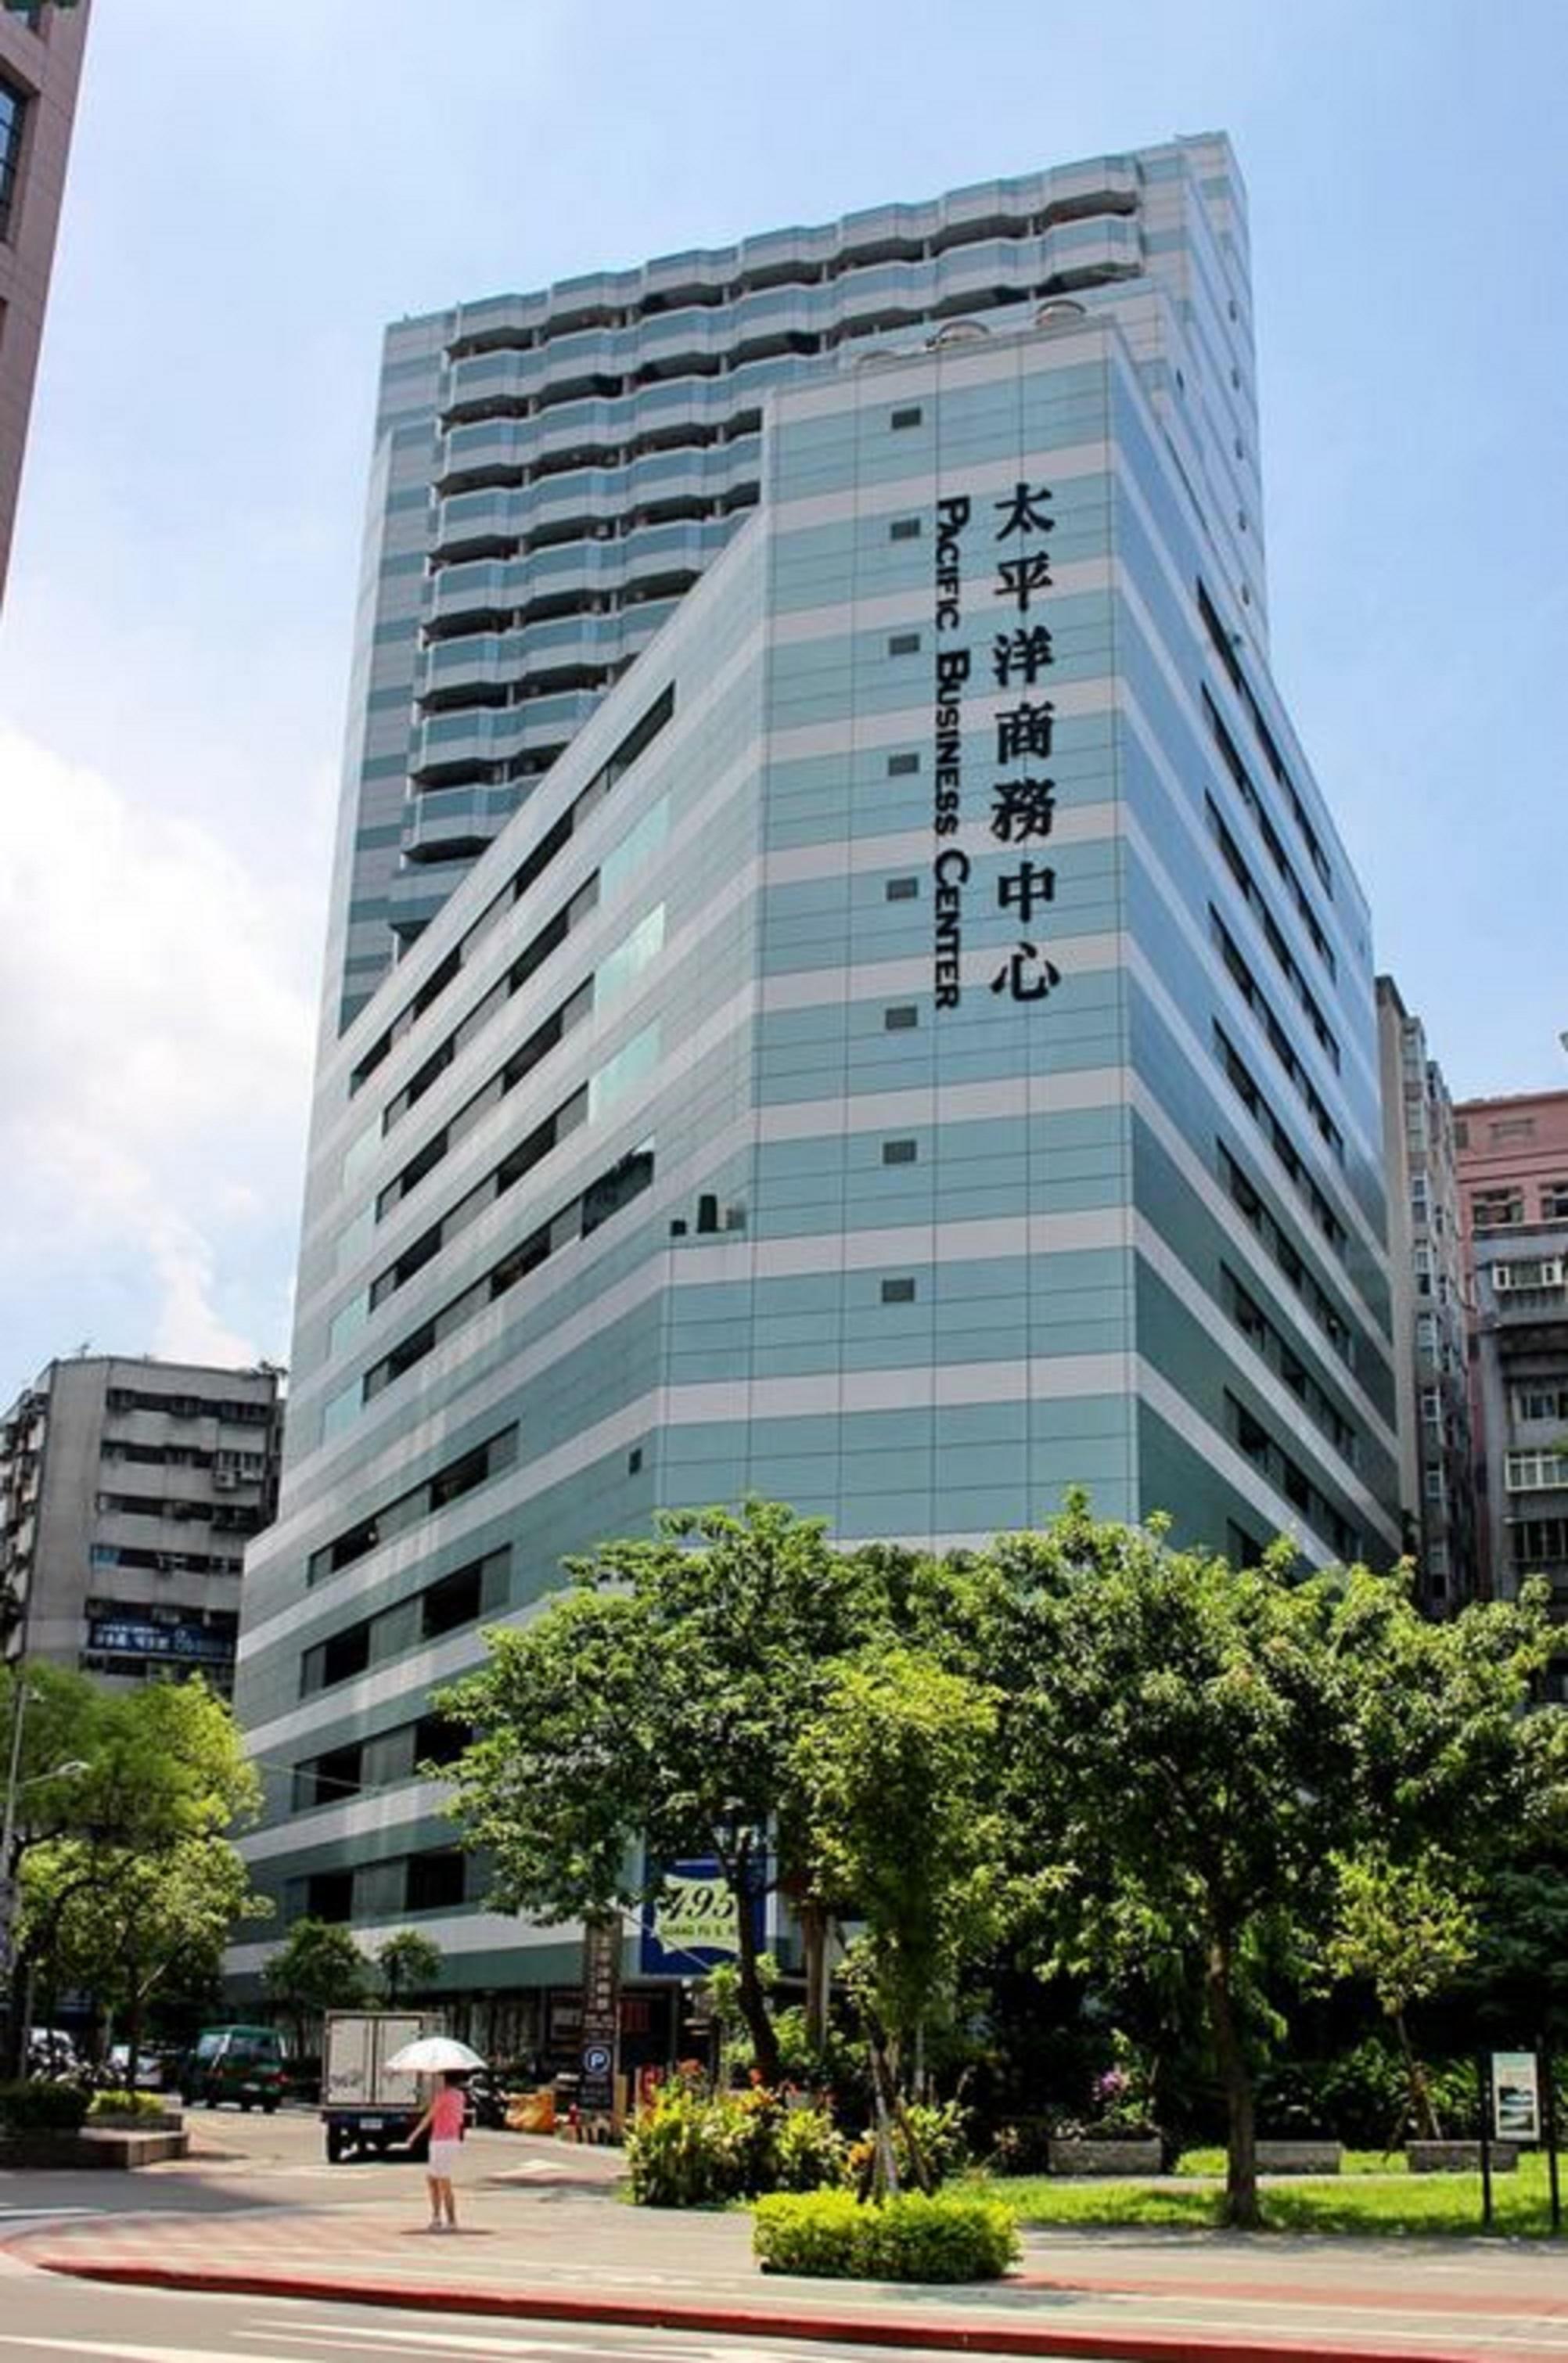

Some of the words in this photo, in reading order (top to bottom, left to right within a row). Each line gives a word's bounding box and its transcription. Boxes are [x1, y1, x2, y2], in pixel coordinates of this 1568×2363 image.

[991, 483, 1061, 1002] 太平洋商務中心
